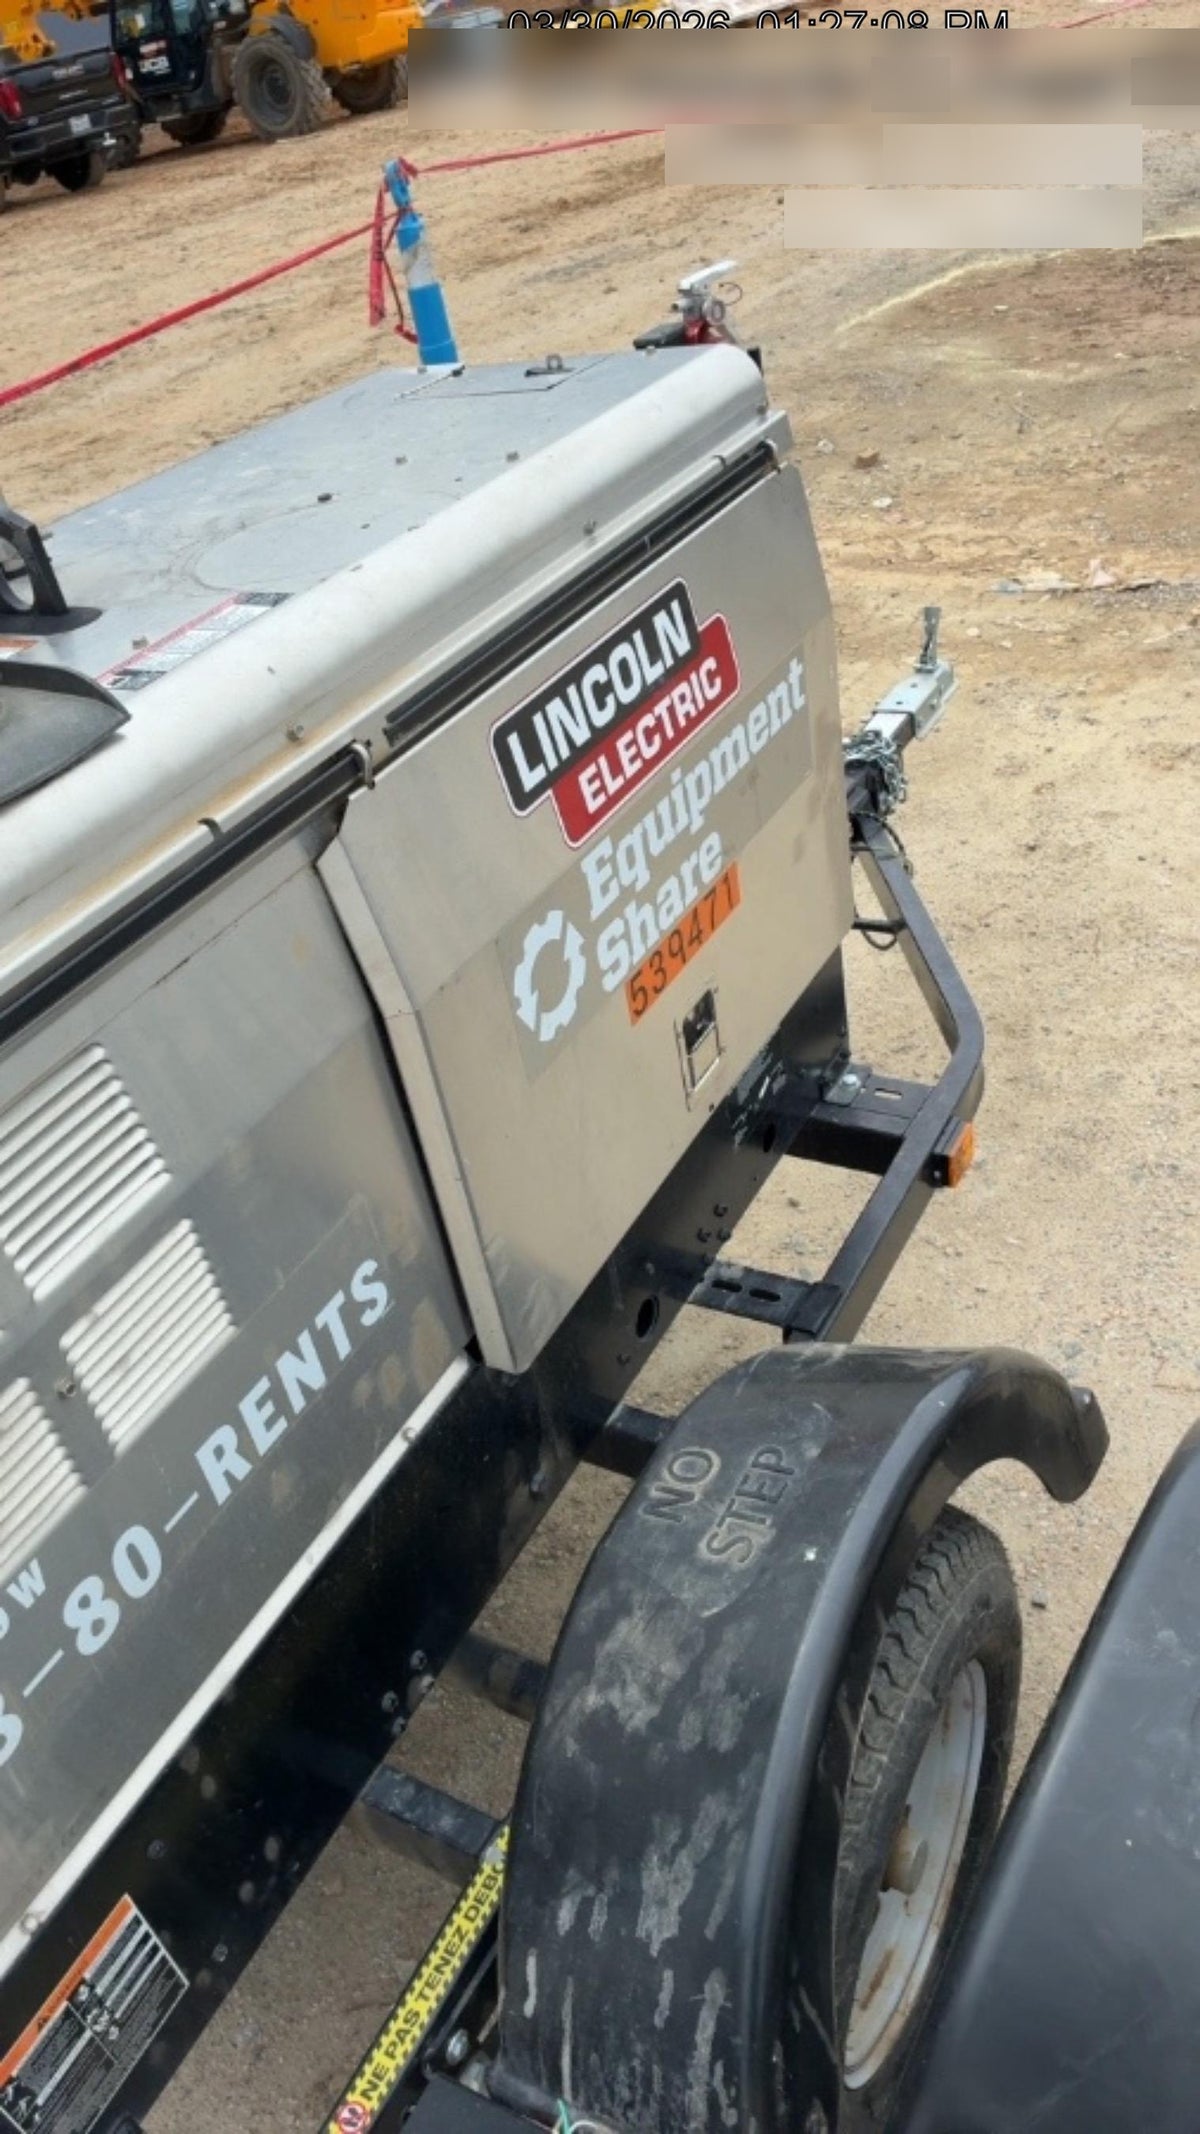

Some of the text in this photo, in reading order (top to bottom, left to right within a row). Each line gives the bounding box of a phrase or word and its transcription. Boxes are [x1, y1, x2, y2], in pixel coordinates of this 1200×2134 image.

[507, 598, 692, 793] LINCOLN
[578, 655, 724, 815] ELECTRIC
[580, 657, 806, 921] Equipment
[598, 831, 723, 993] Share
[630, 872, 735, 1017] 539471
[641, 1449, 715, 1524] NO
[706, 1446, 796, 1564] STEP
[359, 2062, 391, 2101] NE
[386, 2007, 422, 2060] PAS
[415, 1926, 469, 2006] TENEZ
